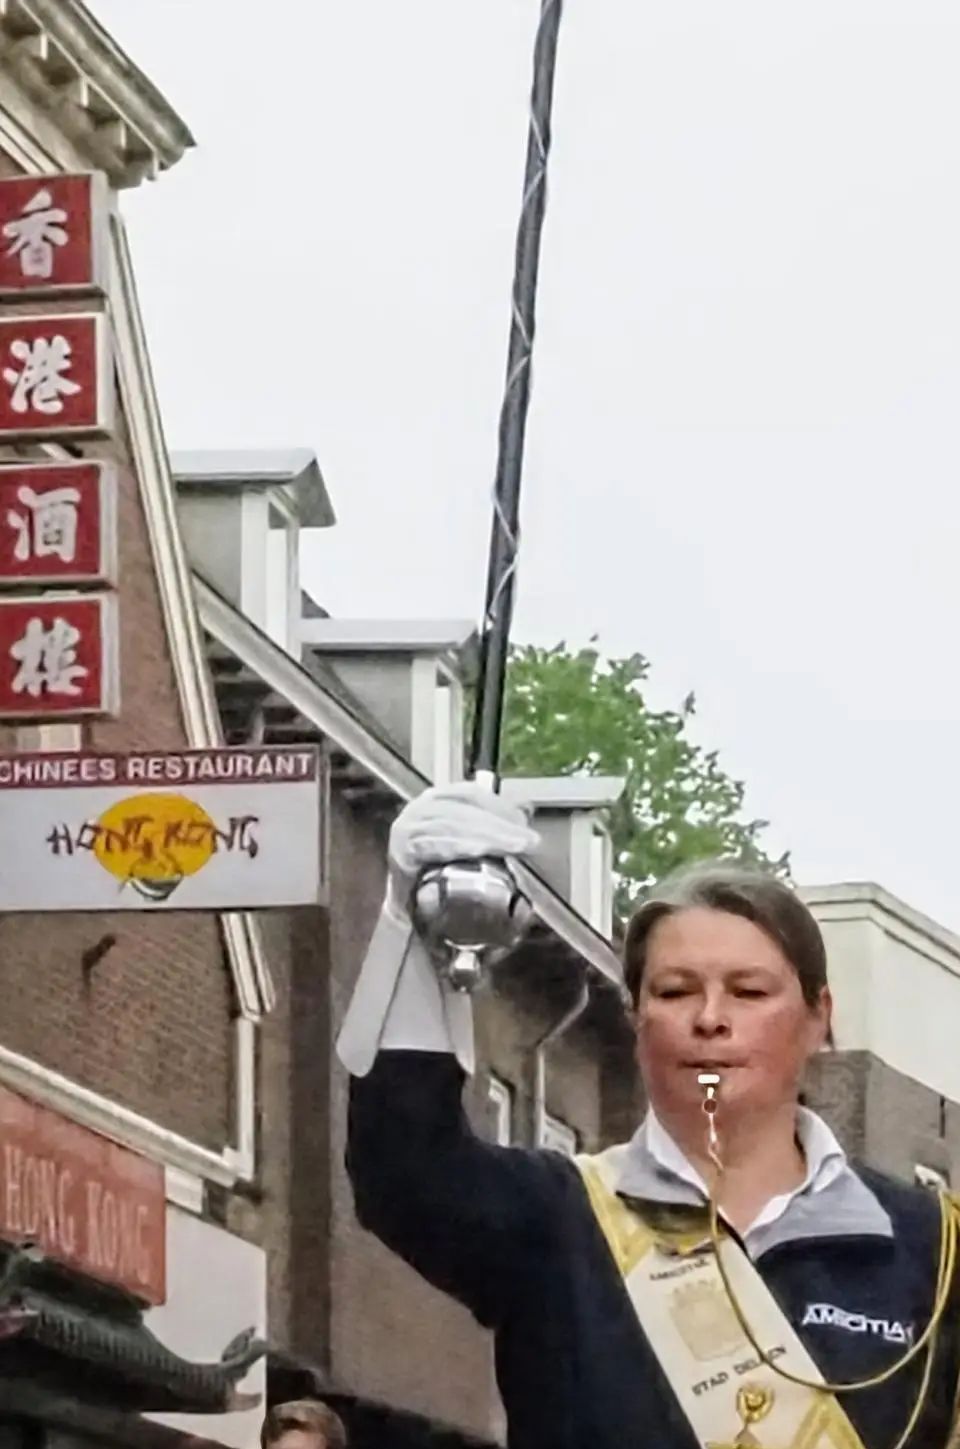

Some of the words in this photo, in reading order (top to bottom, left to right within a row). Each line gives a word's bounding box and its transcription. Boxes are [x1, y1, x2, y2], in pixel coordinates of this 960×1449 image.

[0, 757, 115, 783] CHINEES
[127, 753, 312, 781] RESTAURANT
[46, 816, 154, 859] HONG
[164, 815, 259, 859] KONG
[4, 1145, 75, 1255] HONG
[86, 1180, 149, 1285] KONG
[802, 1303, 905, 1342] AMICITIA
[691, 1371, 729, 1397] STAD
[733, 1346, 786, 1376] DELEN
